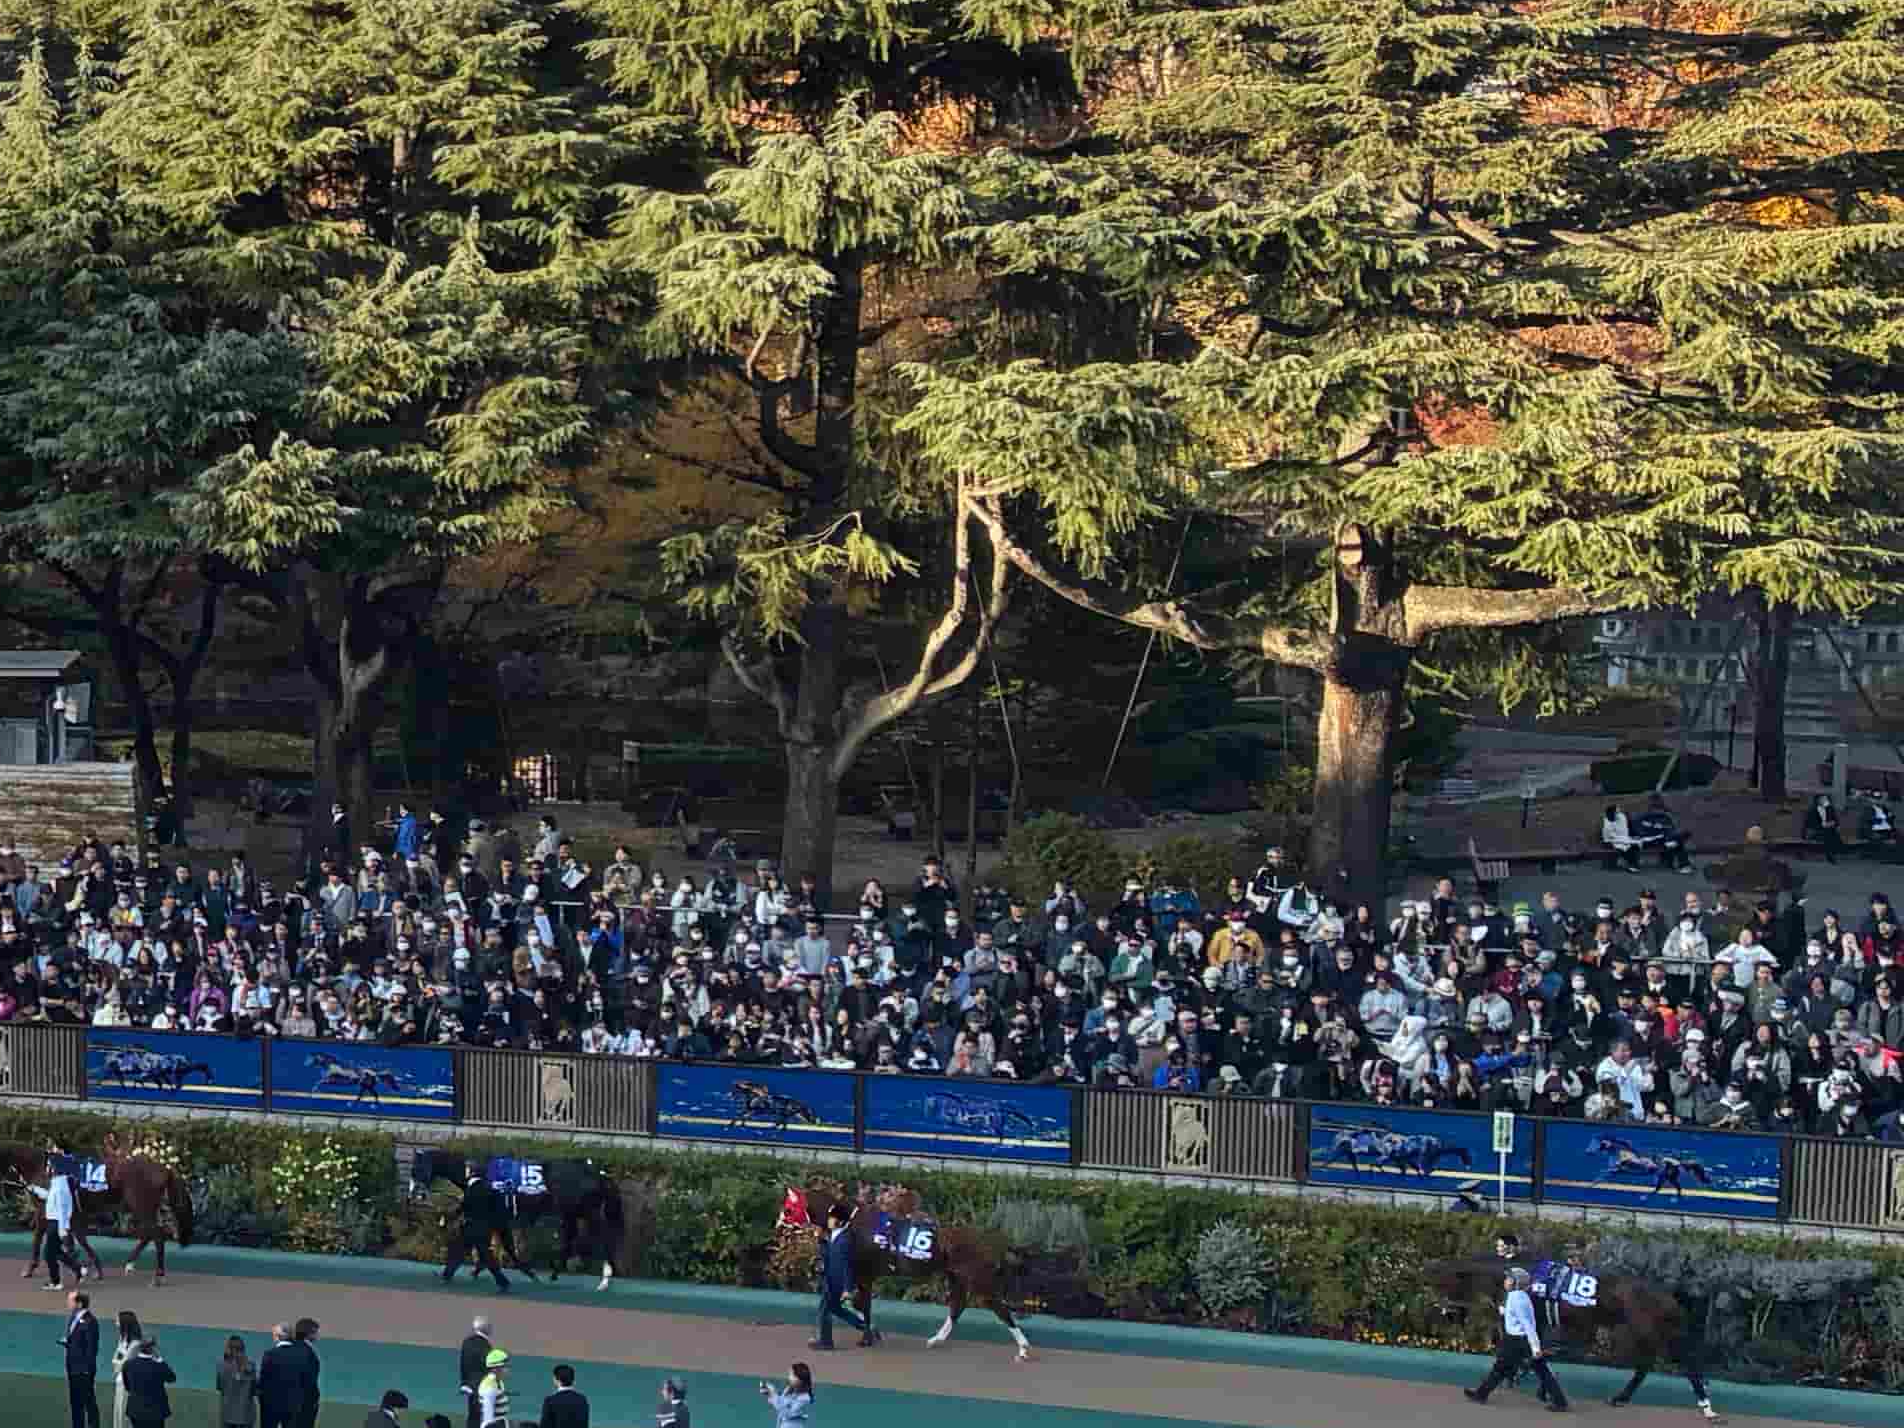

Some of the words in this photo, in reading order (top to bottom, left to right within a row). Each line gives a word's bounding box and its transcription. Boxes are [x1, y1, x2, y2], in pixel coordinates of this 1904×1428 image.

[85, 1162, 106, 1184] 14
[521, 1164, 544, 1185] 15
[907, 1227, 933, 1250] 16
[1570, 1273, 1598, 1298] 18
